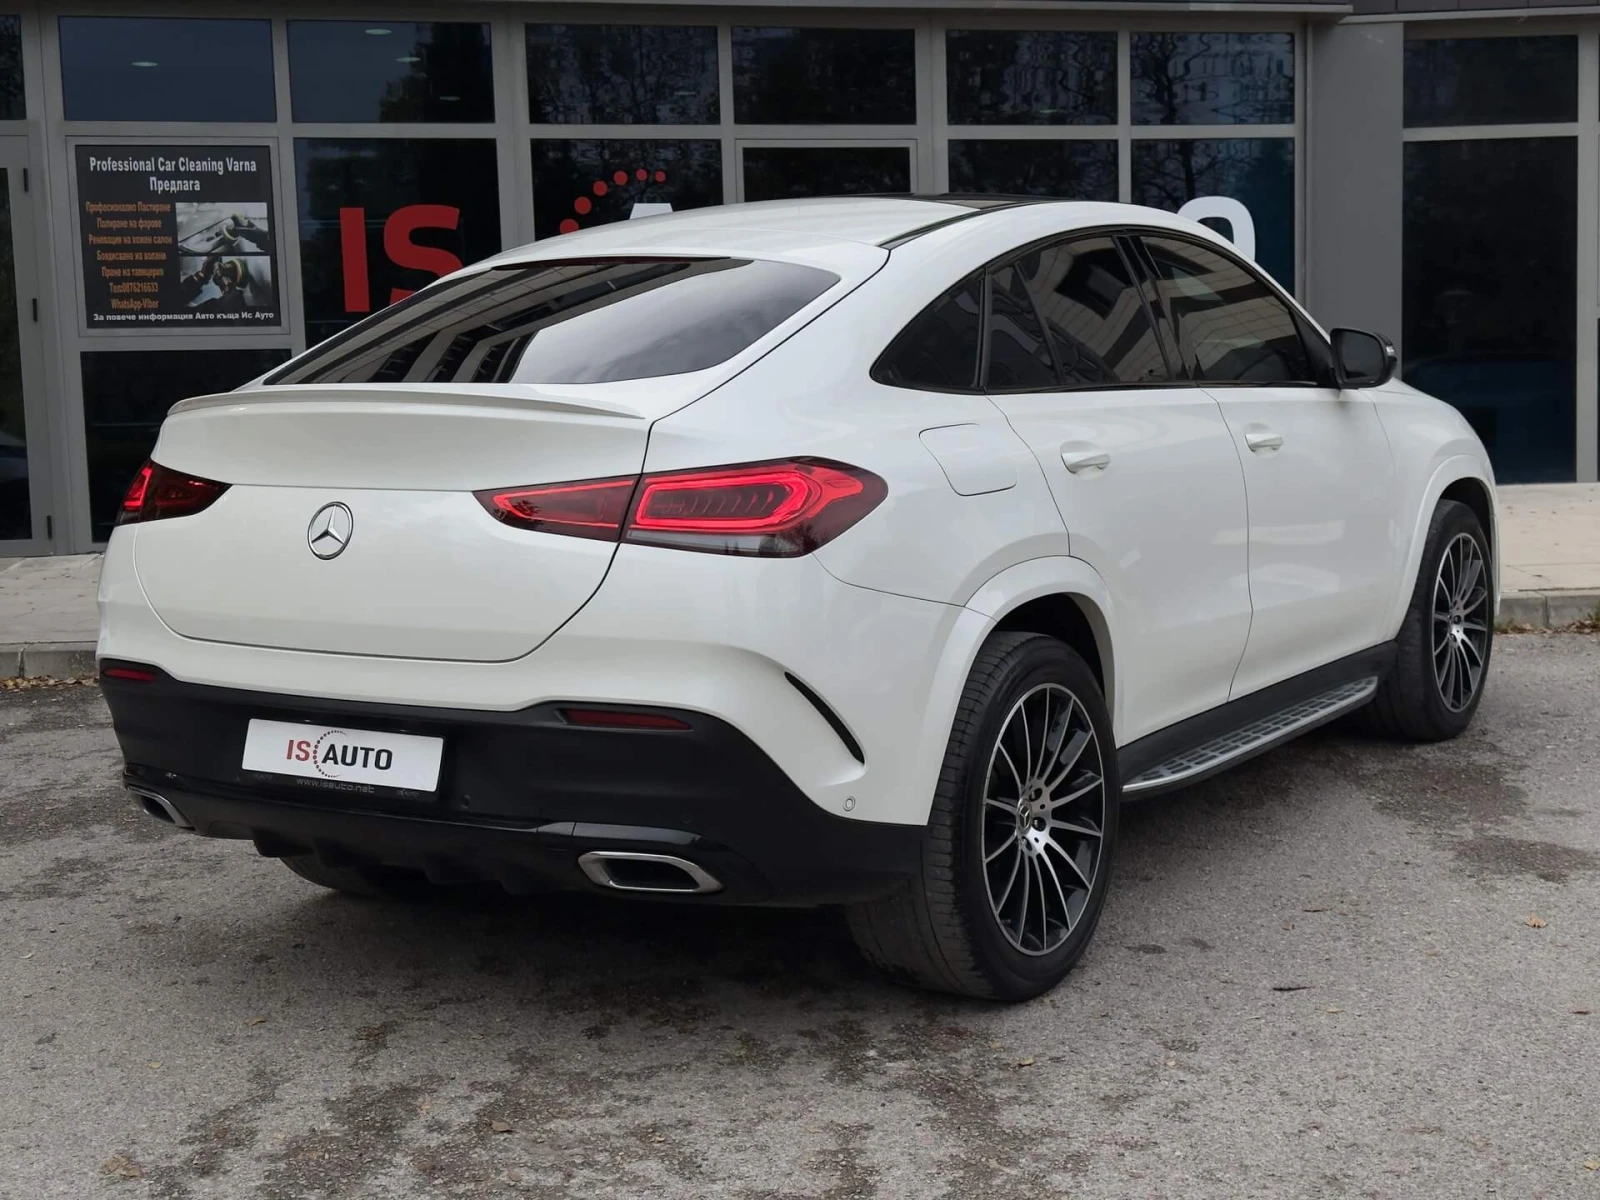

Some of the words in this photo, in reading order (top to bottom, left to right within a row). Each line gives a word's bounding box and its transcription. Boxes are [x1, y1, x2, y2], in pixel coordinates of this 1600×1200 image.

[89, 157, 155, 172] Professional
[157, 157, 176, 172] Car
[178, 157, 224, 175] Cleaning
[226, 157, 257, 172] Varna
[149, 177, 201, 194] Предлага
[93, 313, 105, 321] За
[106, 313, 137, 321] повече
[138, 312, 194, 322] информация
[195, 312, 215, 320] Авто
[216, 312, 240, 321] къща
[241, 311, 253, 319] Ис
[254, 311, 274, 321] Ауто
[286, 739, 311, 762] IS
[321, 743, 393, 771] AUTO
[296, 777, 376, 794] www.isauto.net
